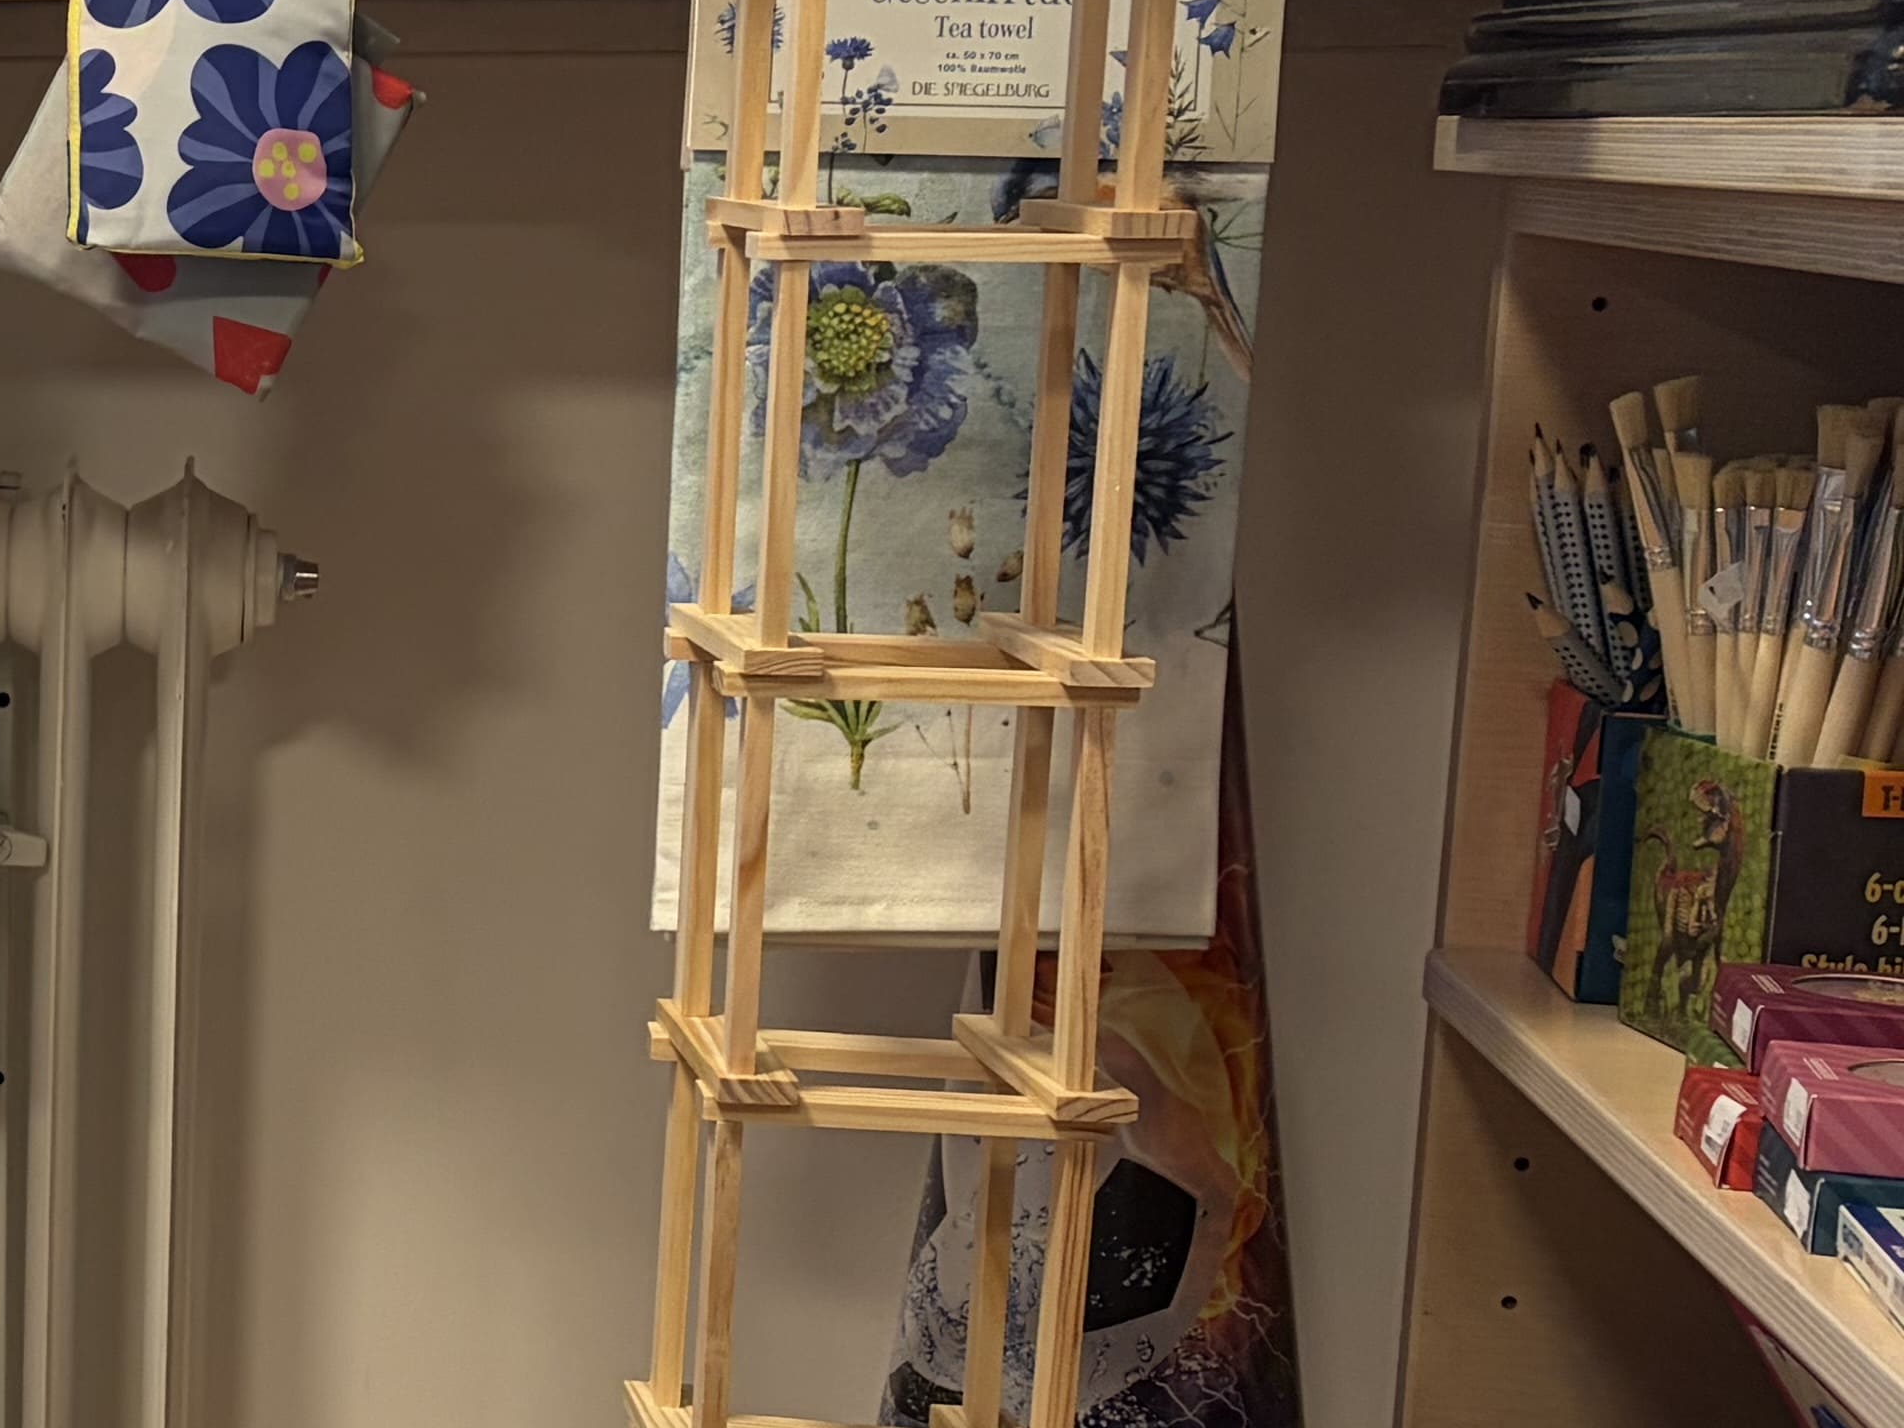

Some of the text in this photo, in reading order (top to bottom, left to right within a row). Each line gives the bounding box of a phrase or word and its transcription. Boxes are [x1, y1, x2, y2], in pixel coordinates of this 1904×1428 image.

[934, 15, 1034, 40] Tea towel
[911, 81, 1051, 99] DIE SPIEGELBURG
